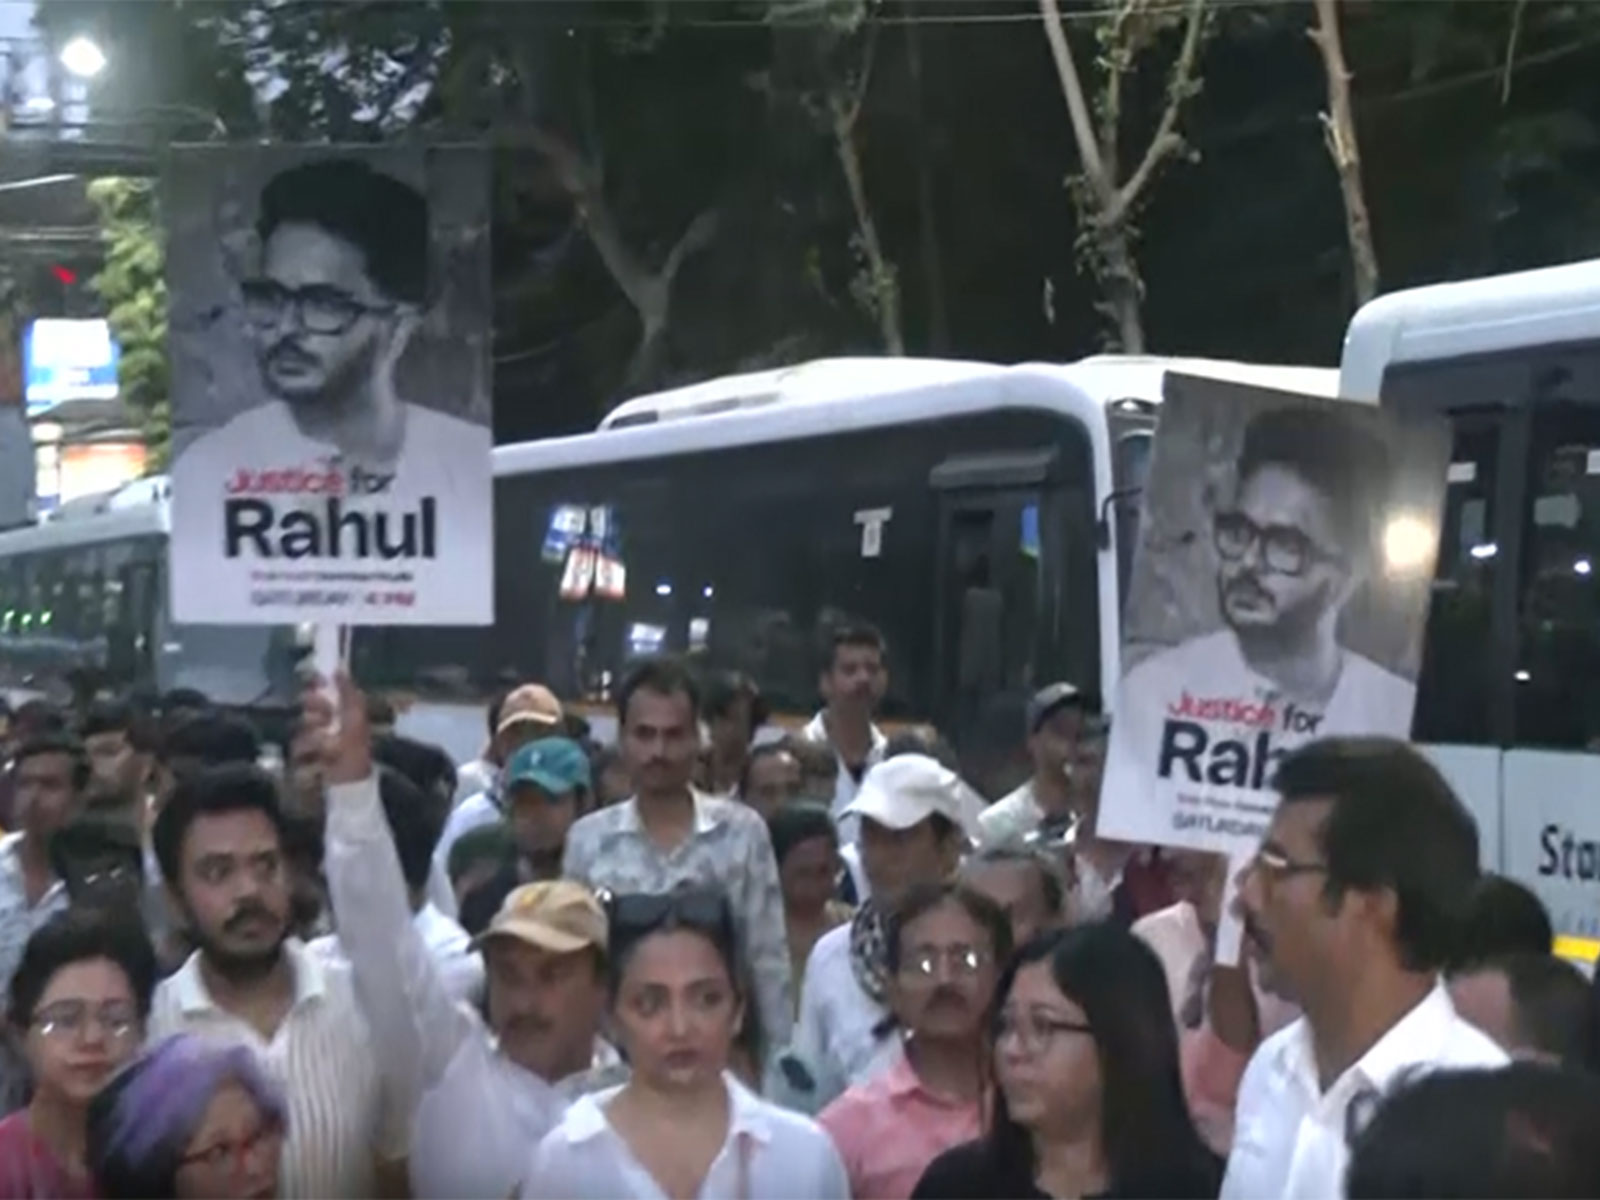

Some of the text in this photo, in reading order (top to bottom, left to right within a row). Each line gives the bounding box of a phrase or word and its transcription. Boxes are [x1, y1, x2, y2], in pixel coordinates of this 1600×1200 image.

[224, 464, 398, 494] Justice for
[225, 496, 436, 560] Rahul
[1167, 690, 1324, 735] Justice for
[1157, 719, 1283, 790] Rah
